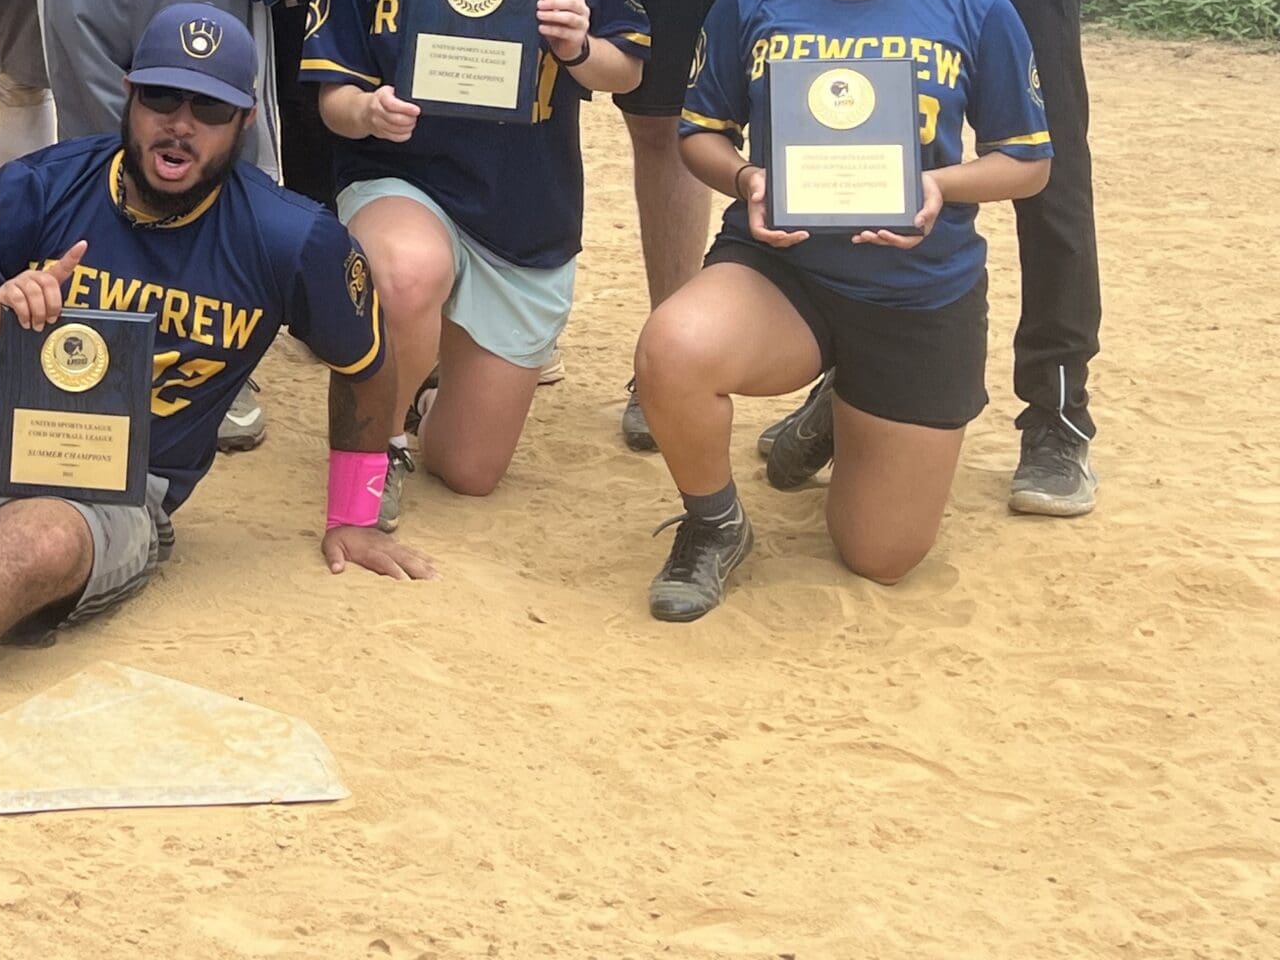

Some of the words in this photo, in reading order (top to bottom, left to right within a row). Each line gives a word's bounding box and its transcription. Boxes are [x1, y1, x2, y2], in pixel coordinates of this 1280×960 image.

[429, 70, 459, 78] SUMMER
[461, 73, 504, 83] CHAMPIONS
[28, 259, 263, 350] EWCREW
[49, 432, 83, 440] SOFTBALL
[85, 434, 113, 442] LEAGUE
[27, 449, 62, 458] SUMMER
[64, 451, 112, 462] CHAMPIONS
